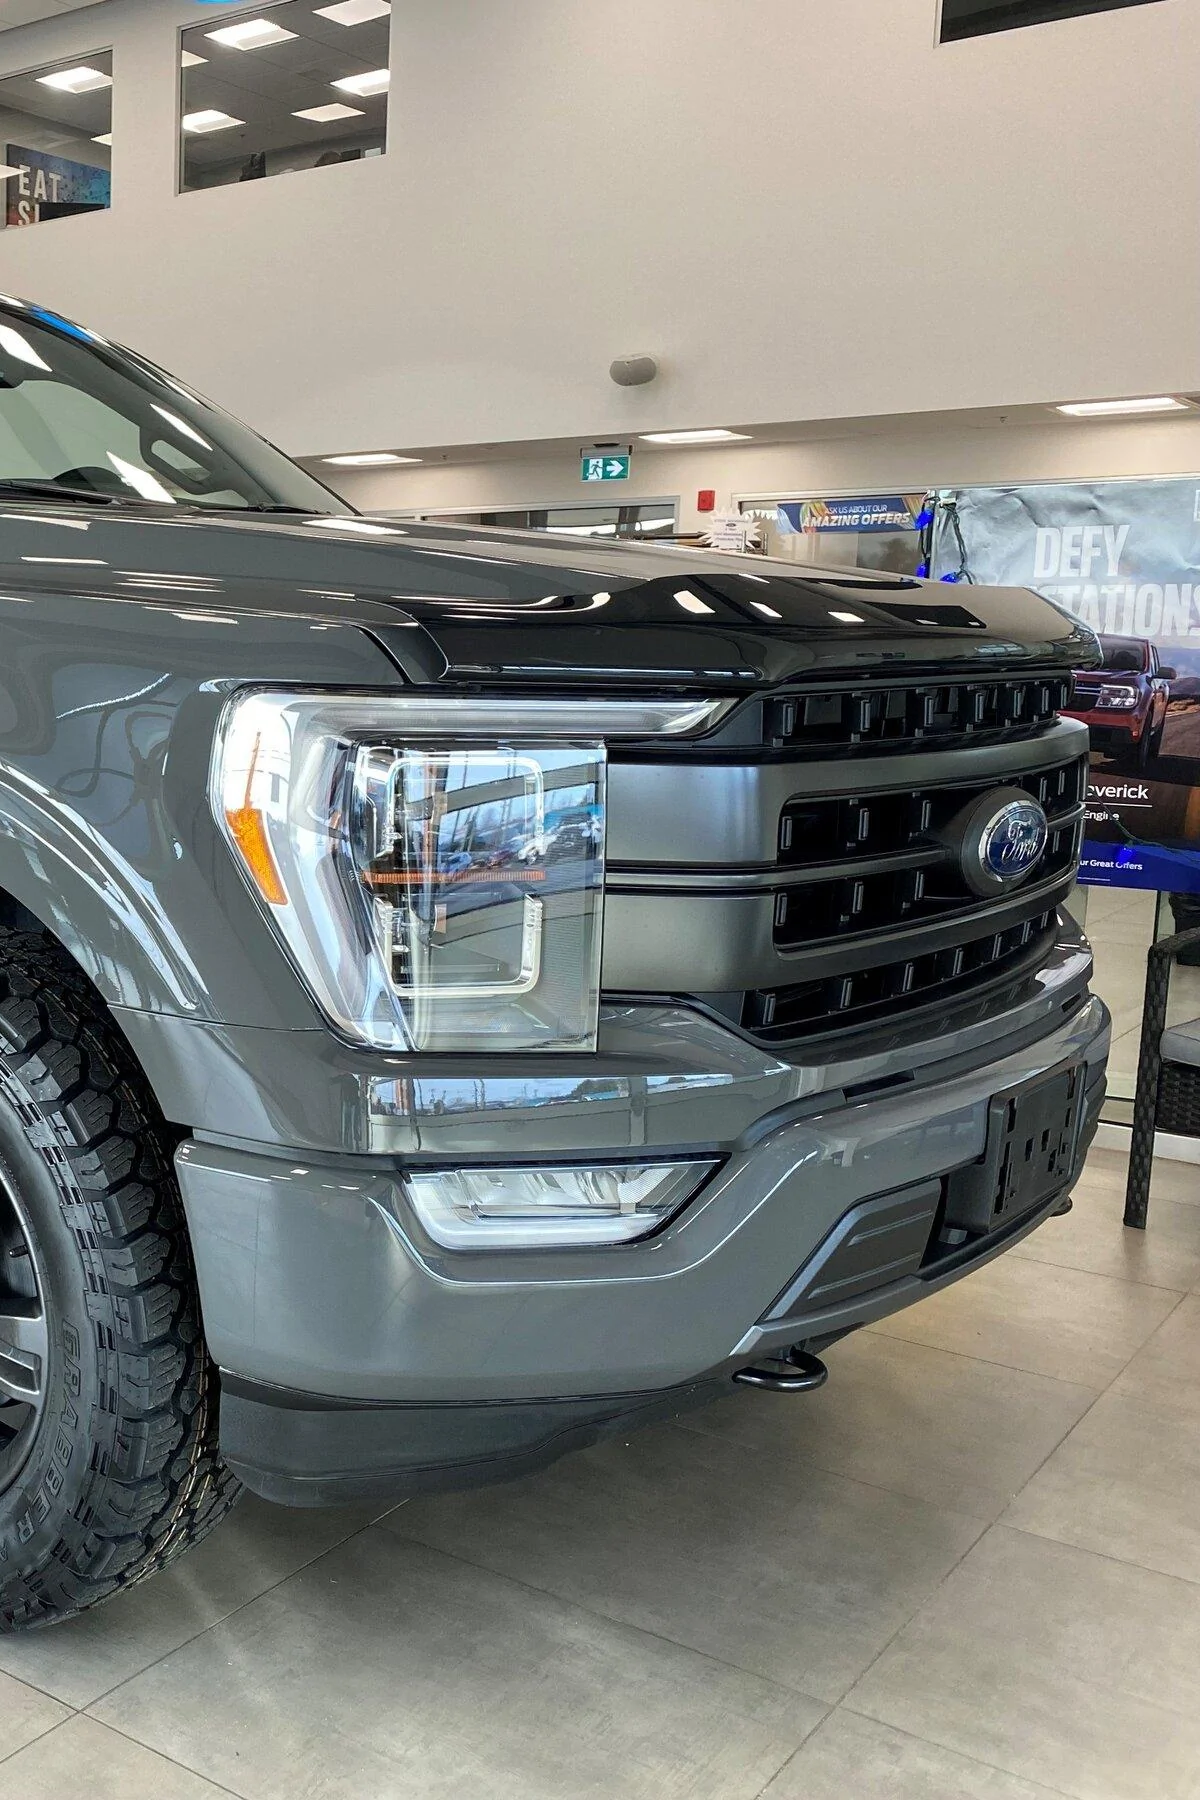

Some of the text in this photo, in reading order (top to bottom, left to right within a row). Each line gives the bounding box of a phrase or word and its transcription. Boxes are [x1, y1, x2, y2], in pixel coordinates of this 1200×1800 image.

[19, 164, 62, 203] EAT
[801, 512, 911, 528] AMAZING OFFERS
[839, 506, 848, 514] US
[848, 504, 873, 514] ABOUT
[872, 504, 888, 512] OUR
[1033, 524, 1131, 578] DEFY
[1002, 819, 1040, 864] Ford
[1089, 859, 1114, 868] Great
[17, 1319, 81, 1545] GRABBER
